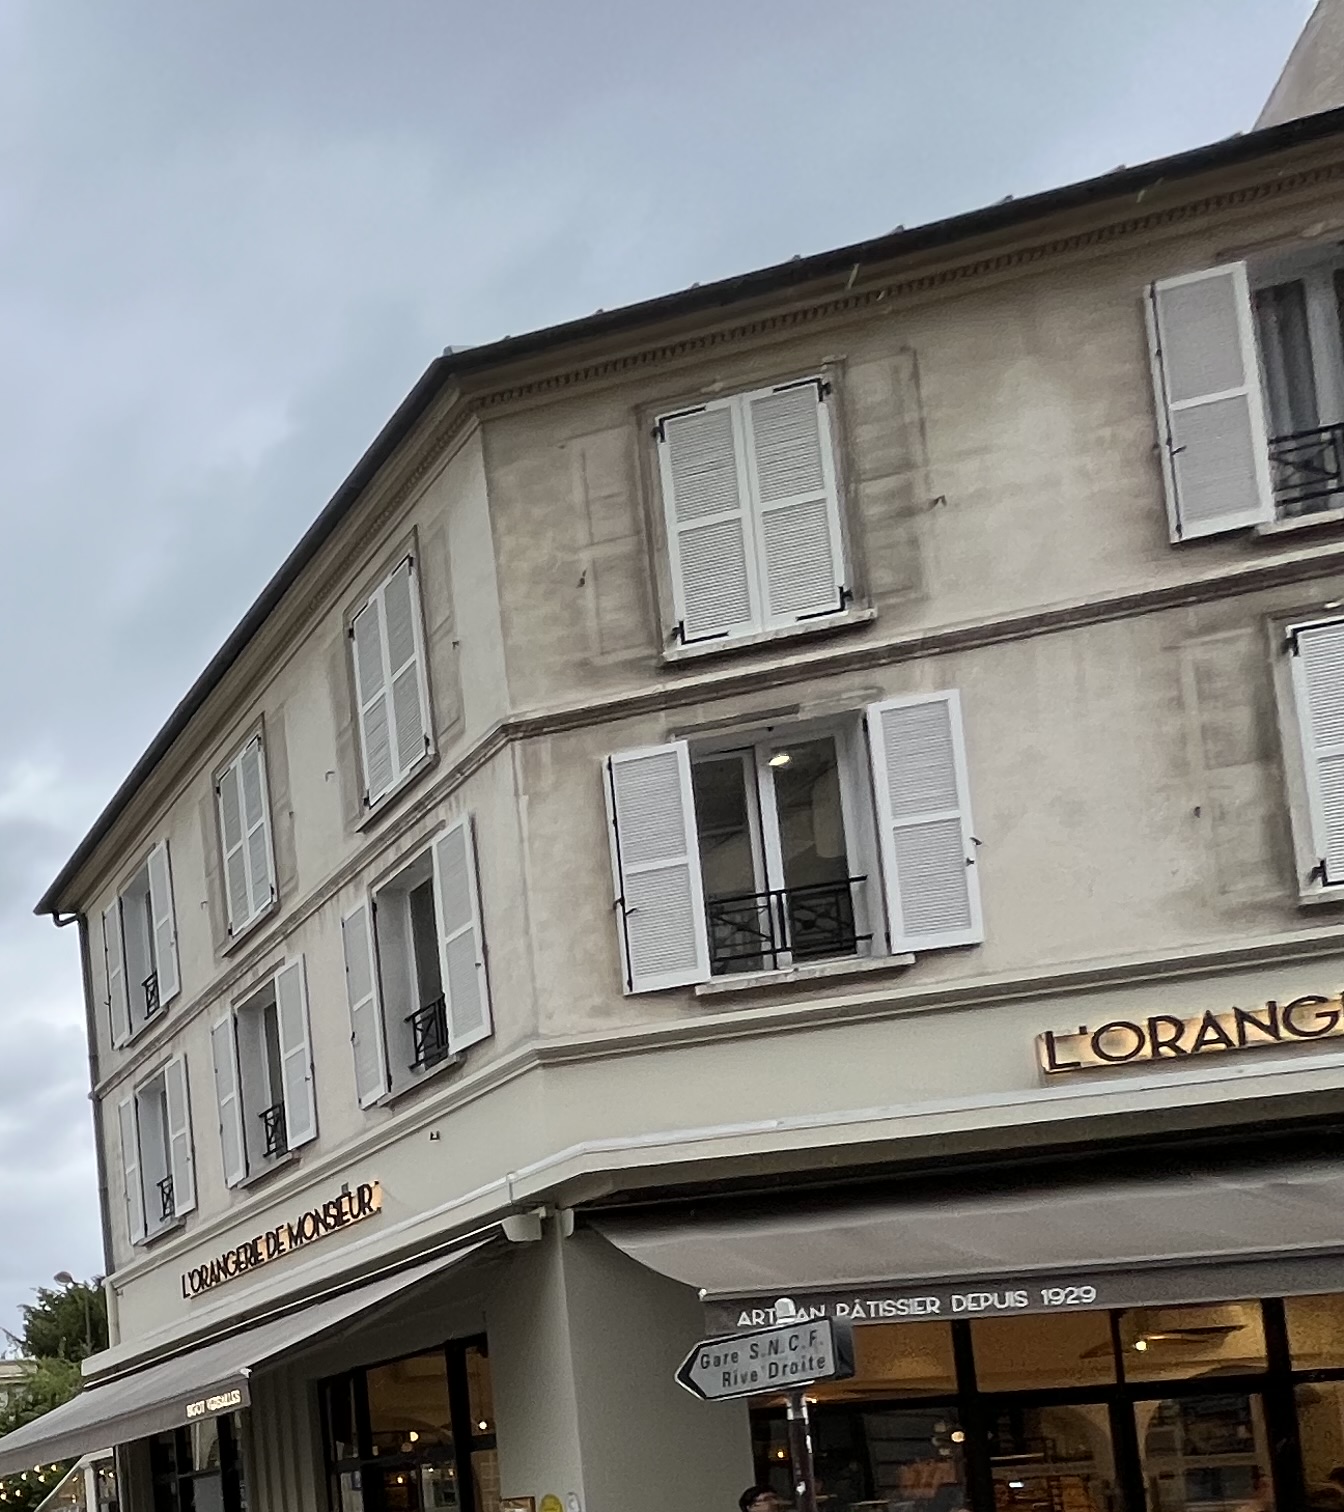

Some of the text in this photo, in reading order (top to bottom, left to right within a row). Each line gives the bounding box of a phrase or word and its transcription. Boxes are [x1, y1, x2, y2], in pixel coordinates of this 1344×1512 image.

[1044, 991, 1344, 1070] L'ORANG
[181, 1235, 265, 1299] L'ORANGERIE
[265, 1225, 287, 1260] DE
[737, 1286, 1097, 1326] ARTAN PÂTISSIER DEPUIS 1929
[700, 1350, 739, 1369] Gare
[722, 1354, 826, 1388] Rive Droite
